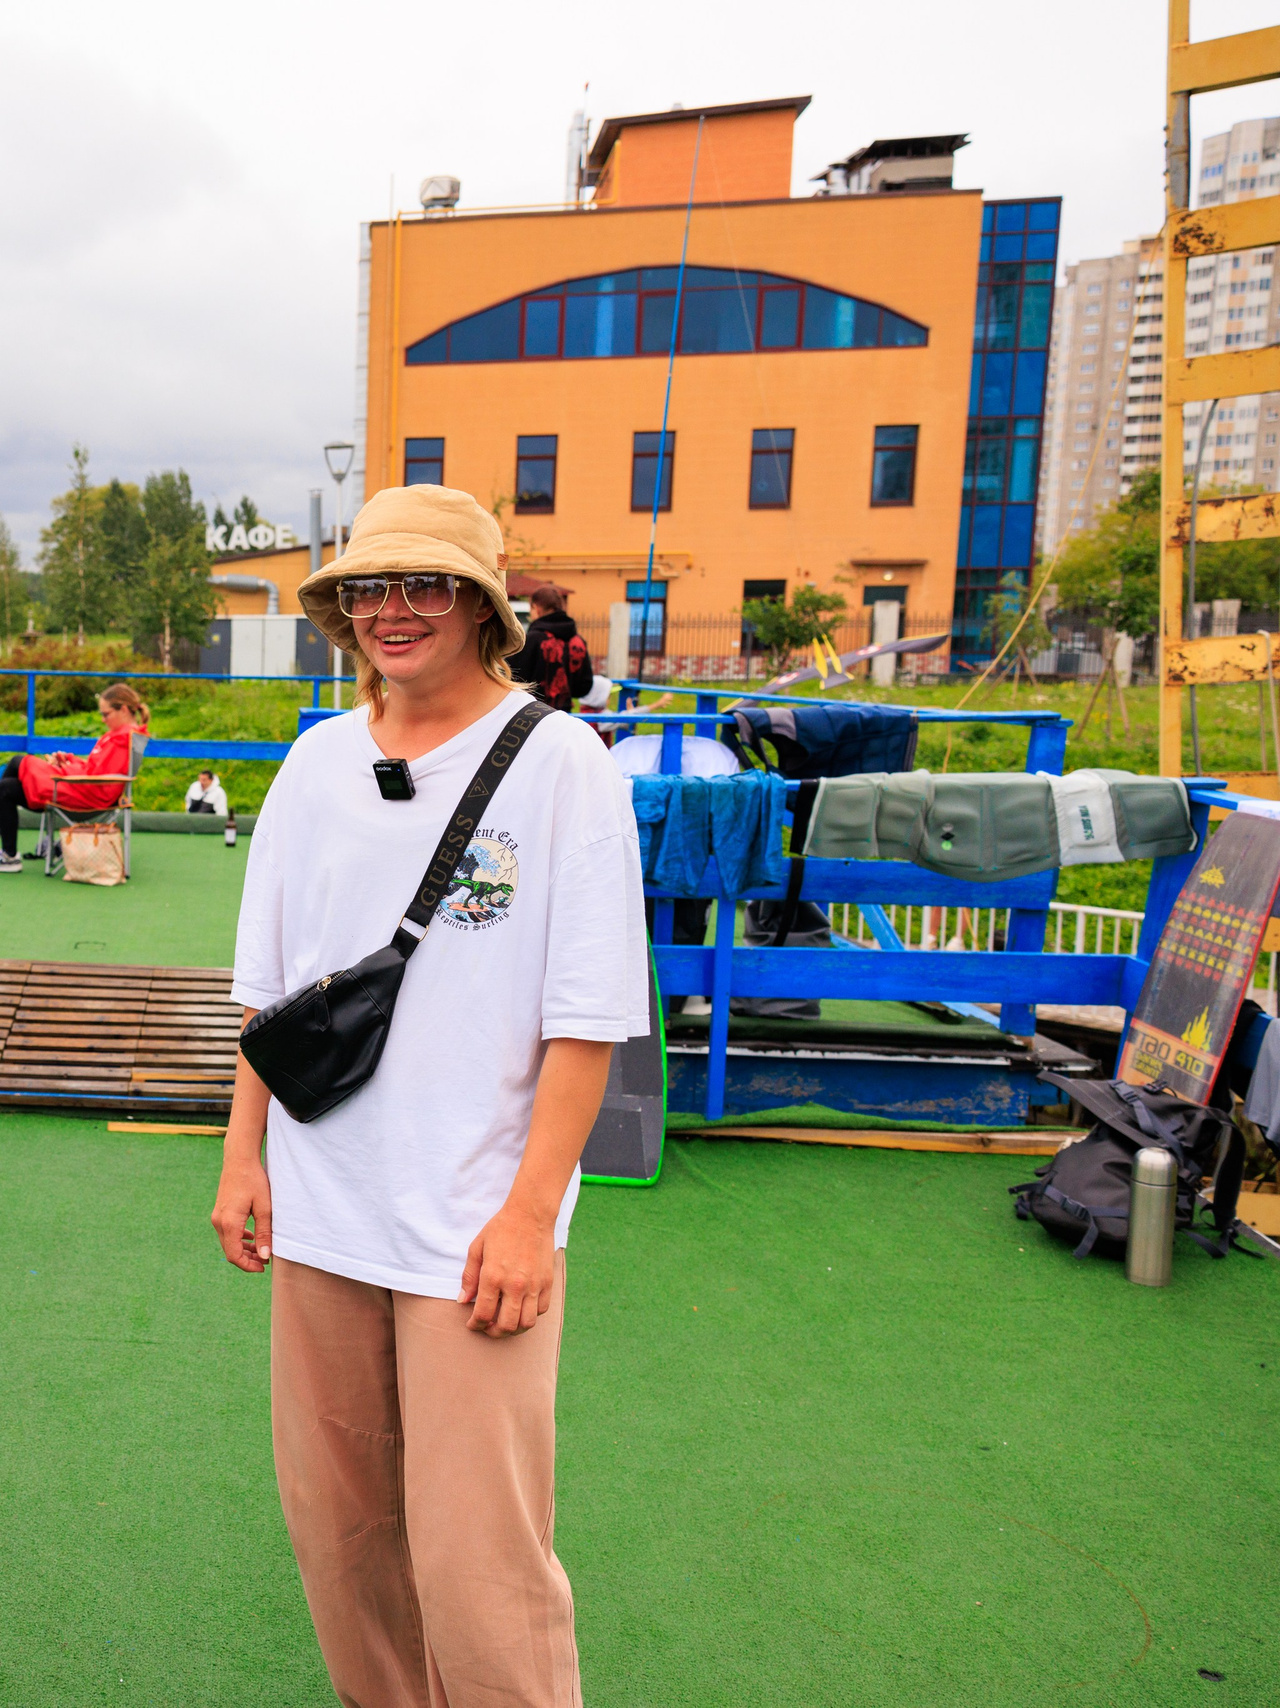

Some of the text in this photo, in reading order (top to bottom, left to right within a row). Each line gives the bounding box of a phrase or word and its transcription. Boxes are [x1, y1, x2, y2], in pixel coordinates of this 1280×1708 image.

[205, 523, 293, 551] КАФЕ
[420, 702, 552, 907] GUESS GUESS
[498, 831, 519, 852] Era
[435, 906, 510, 931] Reptiles Surfing
[1176, 1051, 1205, 1077] 410
